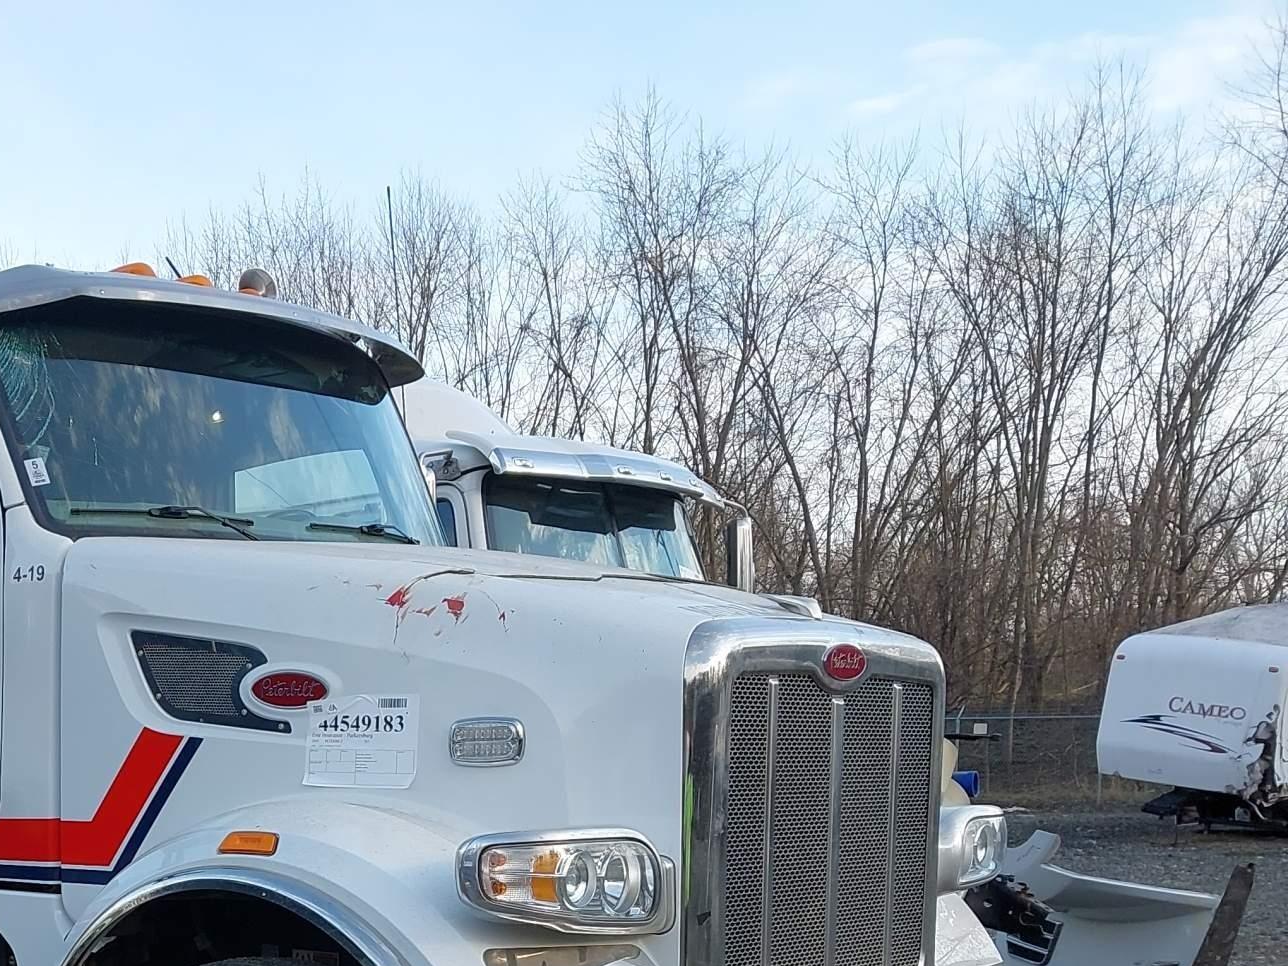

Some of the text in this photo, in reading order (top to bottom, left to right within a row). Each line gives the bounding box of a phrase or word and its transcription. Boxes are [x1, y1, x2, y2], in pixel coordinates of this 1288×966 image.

[12, 564, 45, 583] 4-19
[261, 678, 321, 698] Peterbilt
[1168, 696, 1246, 721] CAMEO
[318, 714, 405, 733] 44549183
